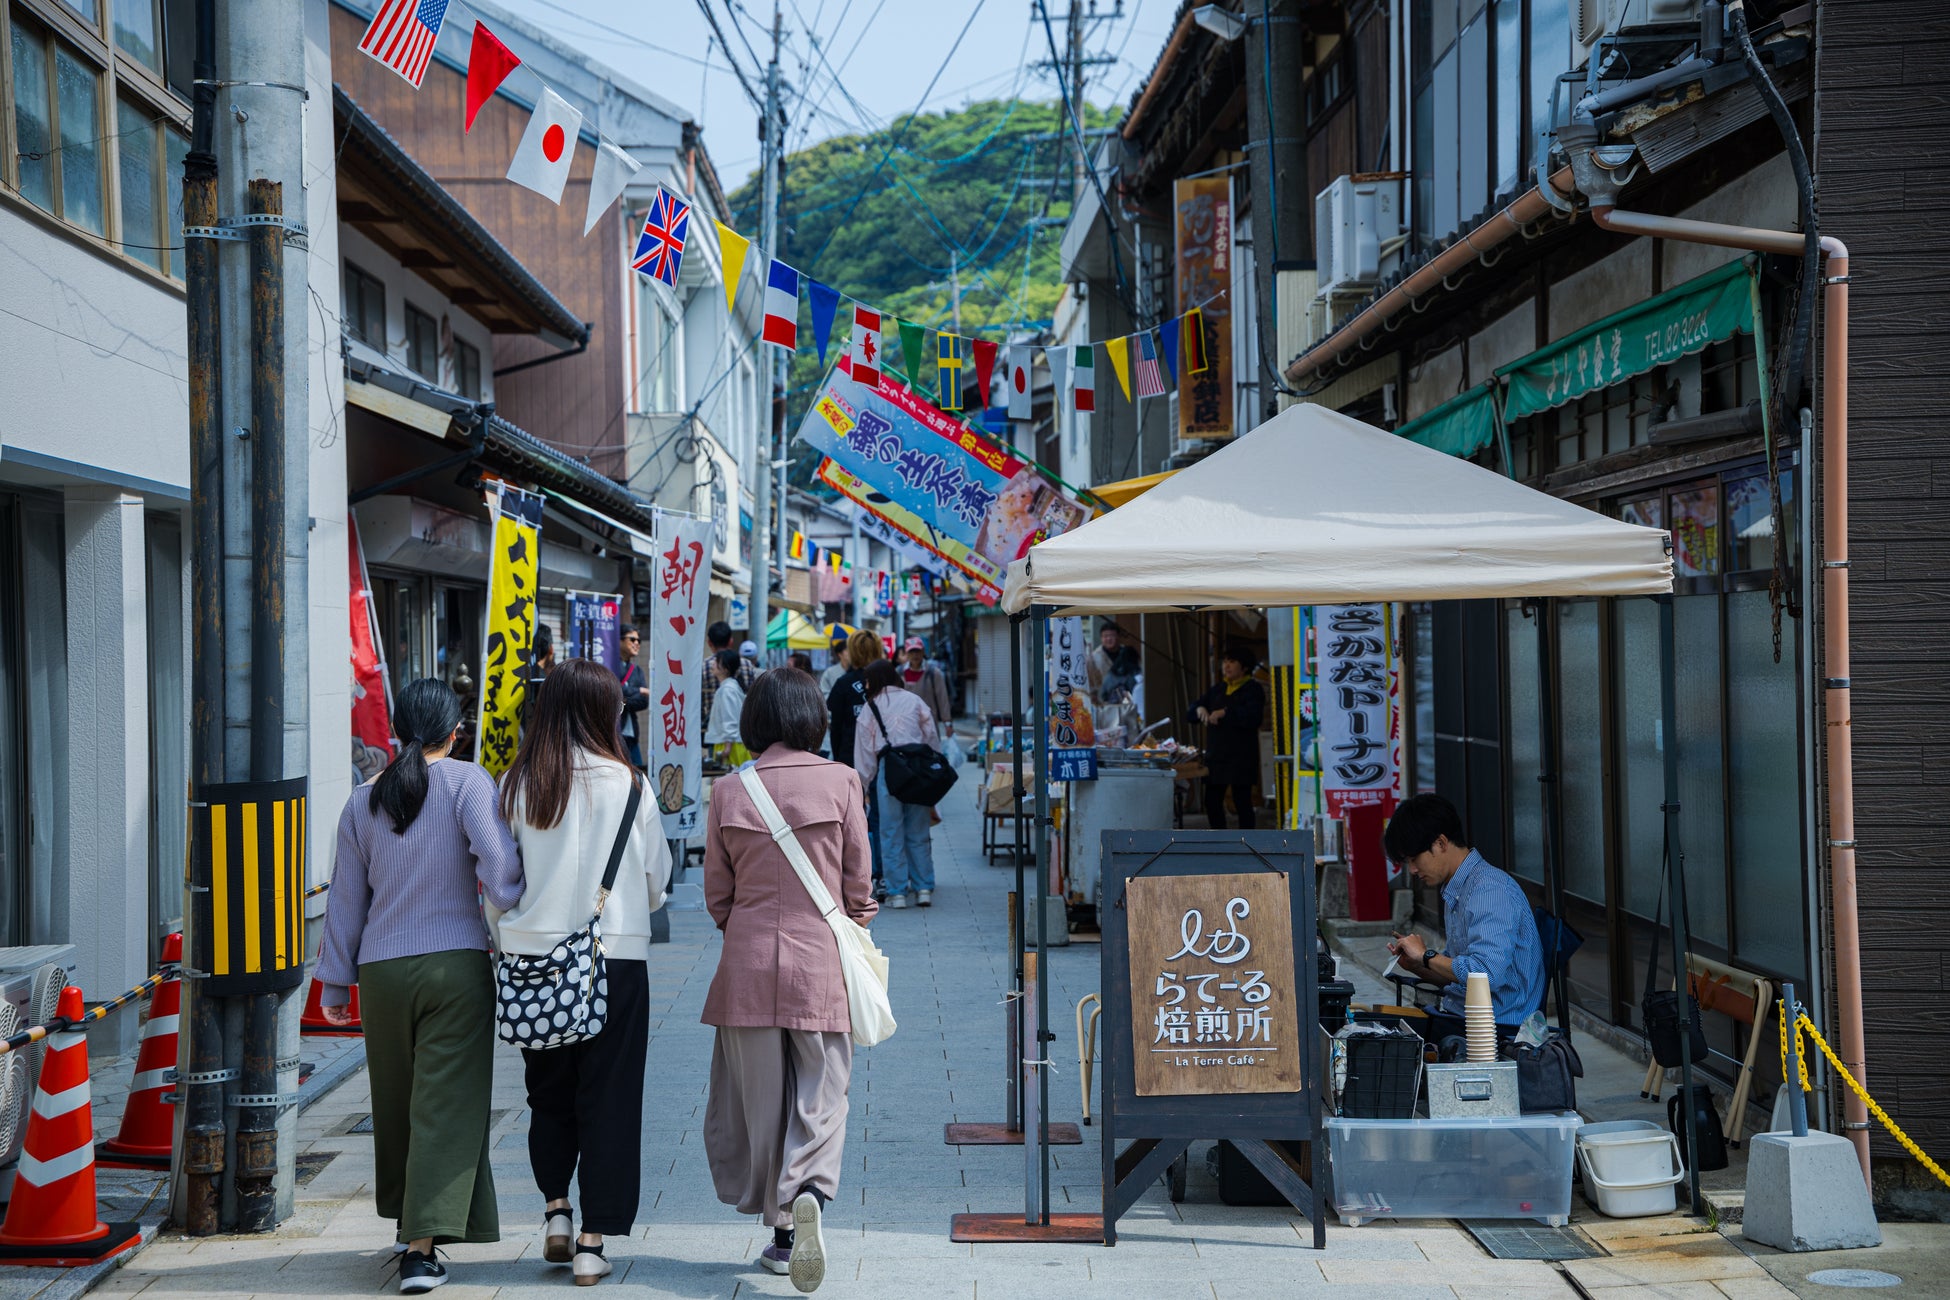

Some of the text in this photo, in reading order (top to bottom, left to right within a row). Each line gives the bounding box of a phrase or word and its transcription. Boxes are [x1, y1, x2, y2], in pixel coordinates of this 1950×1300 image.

[1645, 330, 1663, 362] TEL
[847, 409, 998, 528] 鯛の生茶漬
[1060, 759, 1090, 778] 木屋
[1155, 970, 1271, 1006] らてーる
[1154, 1005, 1273, 1044] 焙煎所
[1176, 1057, 1188, 1066] La
[1193, 1056, 1223, 1065] Terre
